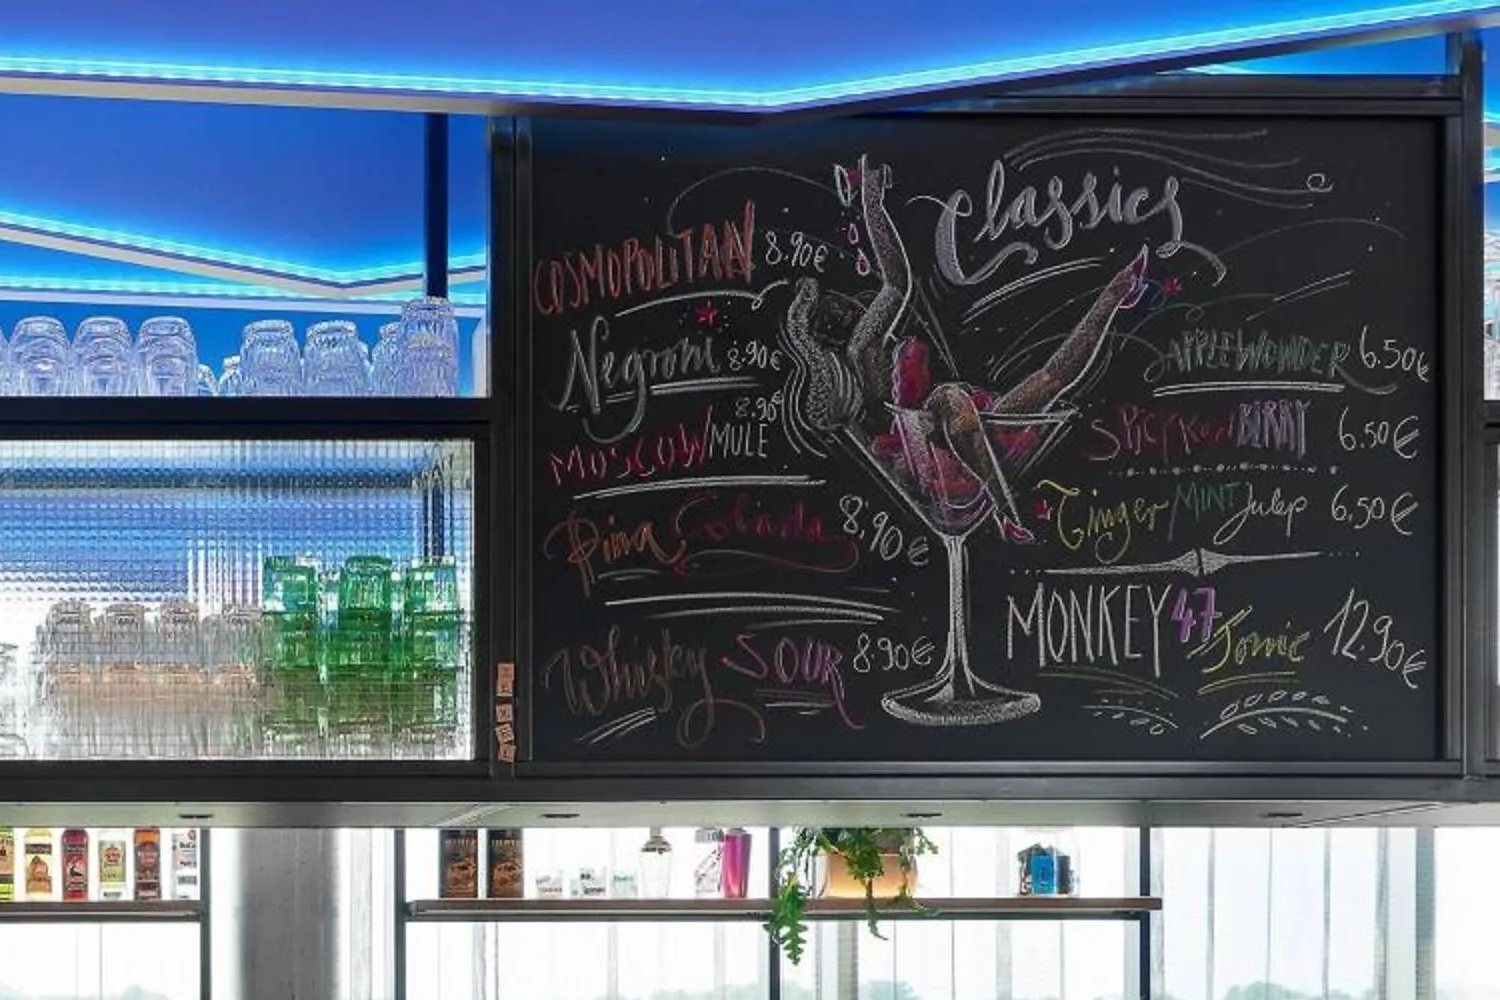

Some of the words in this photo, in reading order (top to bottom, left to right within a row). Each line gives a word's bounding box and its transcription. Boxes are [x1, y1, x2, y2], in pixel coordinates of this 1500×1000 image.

[534, 196, 756, 317] COSMOPOLITAN
[904, 160, 1227, 288] Classics
[549, 315, 722, 443] Negroni
[708, 422, 769, 459] MULE
[1168, 481, 1241, 543] MINT
[1211, 481, 1309, 546] Julep
[1006, 583, 1173, 679] MONKEY
[1171, 586, 1222, 644] 47
[1186, 605, 1311, 675] Tonic
[719, 632, 867, 730] SOUR
